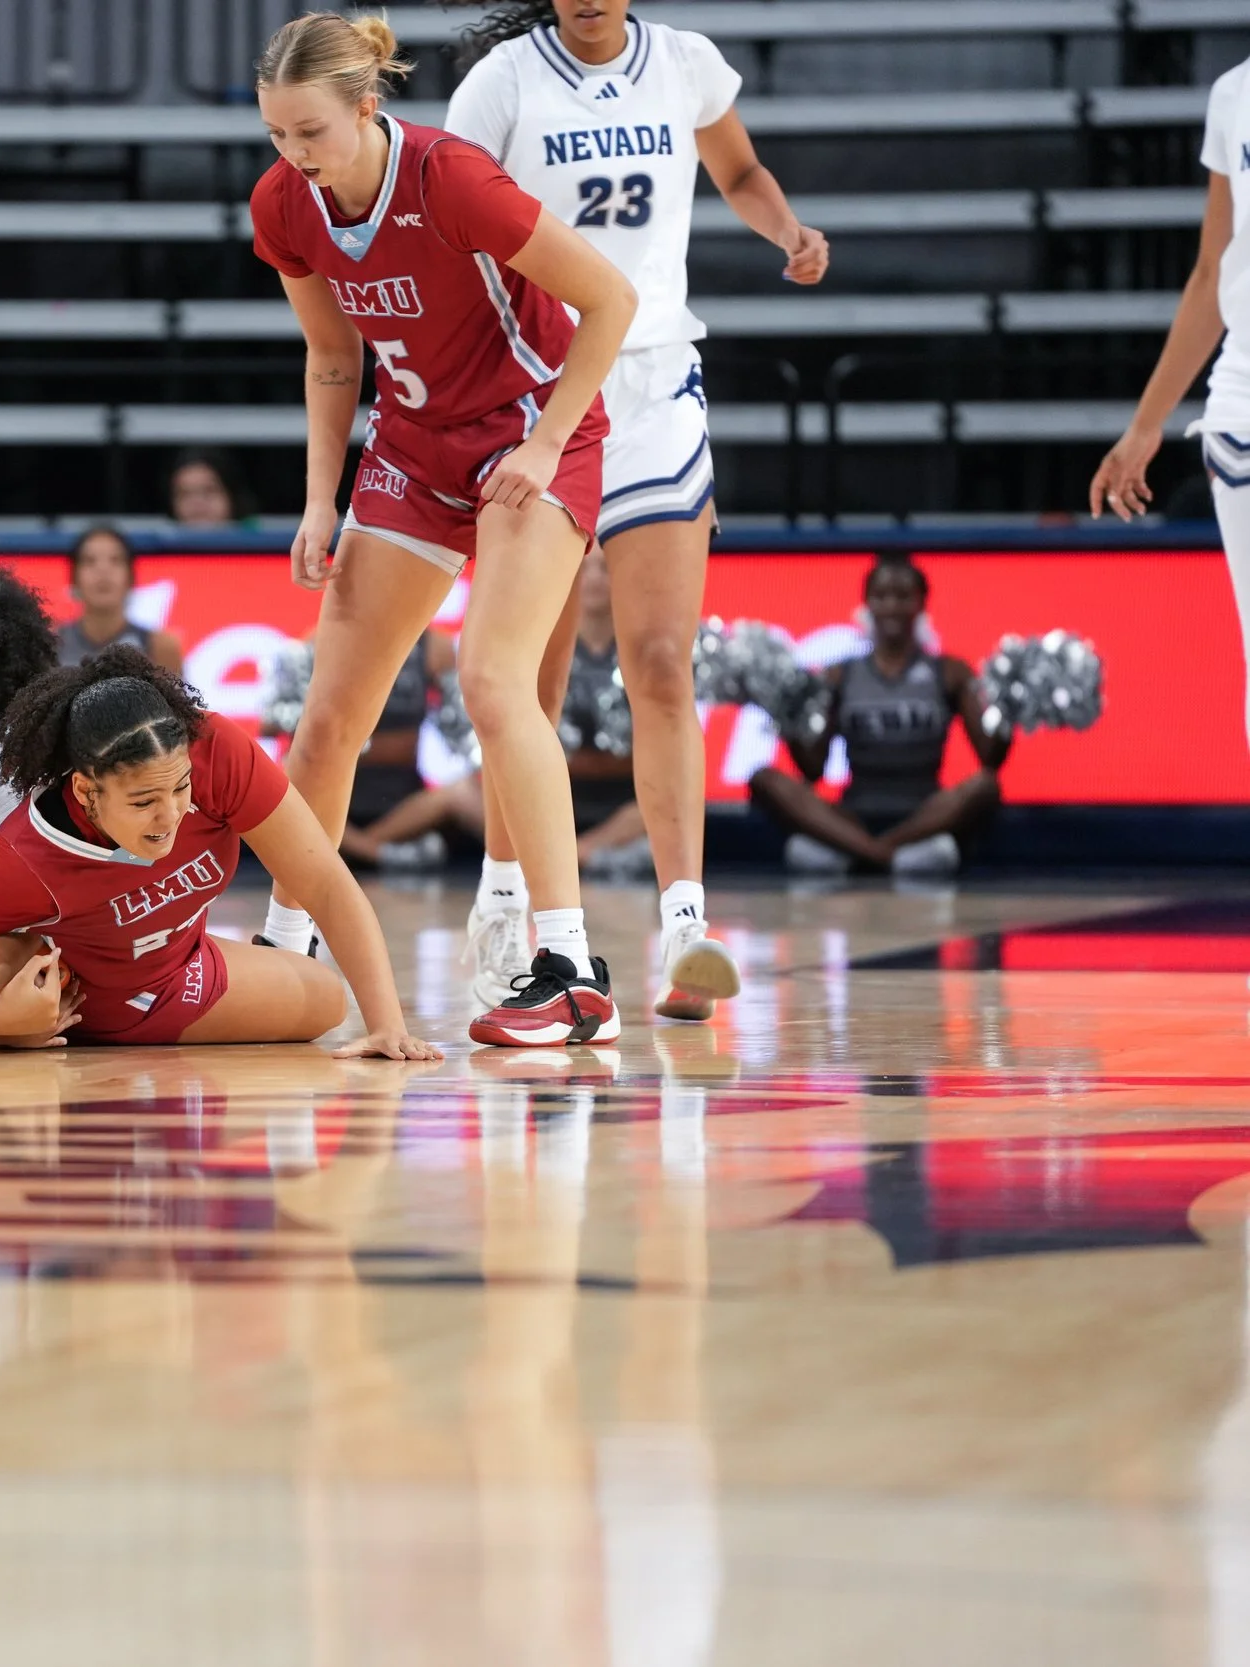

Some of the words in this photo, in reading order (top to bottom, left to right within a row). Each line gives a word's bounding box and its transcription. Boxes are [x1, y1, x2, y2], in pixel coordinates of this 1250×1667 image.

[543, 124, 673, 166] NEVADA
[573, 170, 654, 230] 23
[327, 275, 424, 318] LMU
[372, 339, 428, 410] 5
[359, 468, 408, 500] LMU
[110, 849, 225, 927] LMU
